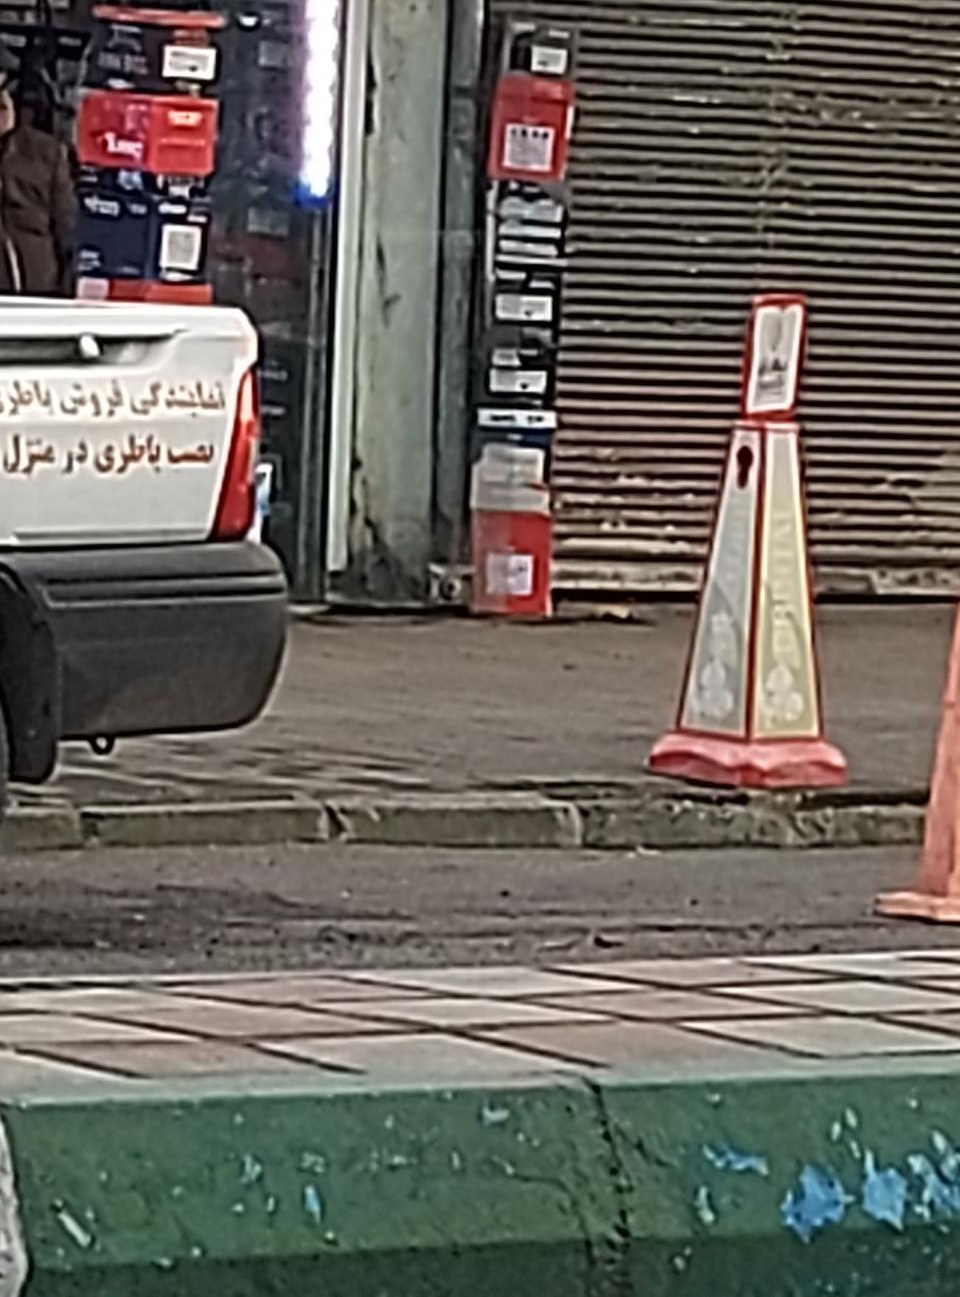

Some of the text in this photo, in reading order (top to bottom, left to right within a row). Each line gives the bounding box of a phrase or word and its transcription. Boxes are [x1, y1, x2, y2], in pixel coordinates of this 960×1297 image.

[59, 379, 124, 417] فروش
[130, 381, 226, 418] نمایندگی
[2, 433, 55, 476] منزل
[61, 440, 88, 474] در
[94, 434, 161, 474] باطری
